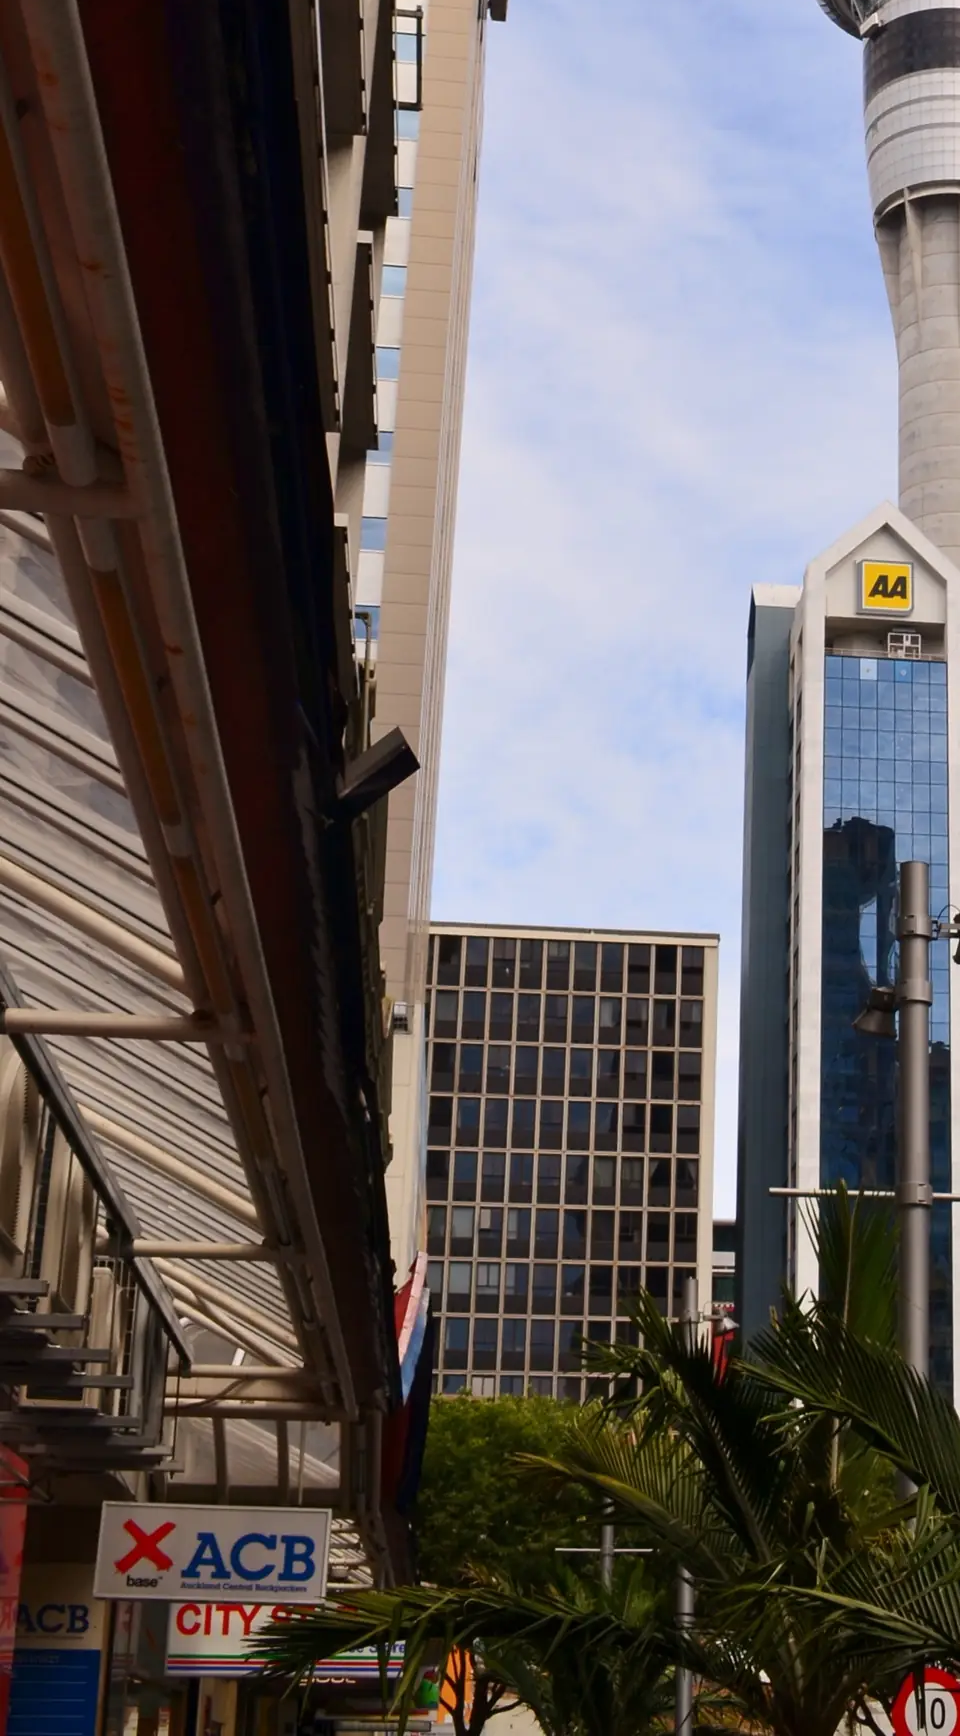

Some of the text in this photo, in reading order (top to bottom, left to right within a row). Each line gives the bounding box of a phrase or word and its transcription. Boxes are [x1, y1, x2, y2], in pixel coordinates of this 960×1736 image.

[868, 575, 908, 599] AA
[181, 1532, 315, 1581] ACB
[17, 1604, 89, 1633] ACB
[176, 1604, 261, 1636] CITY
